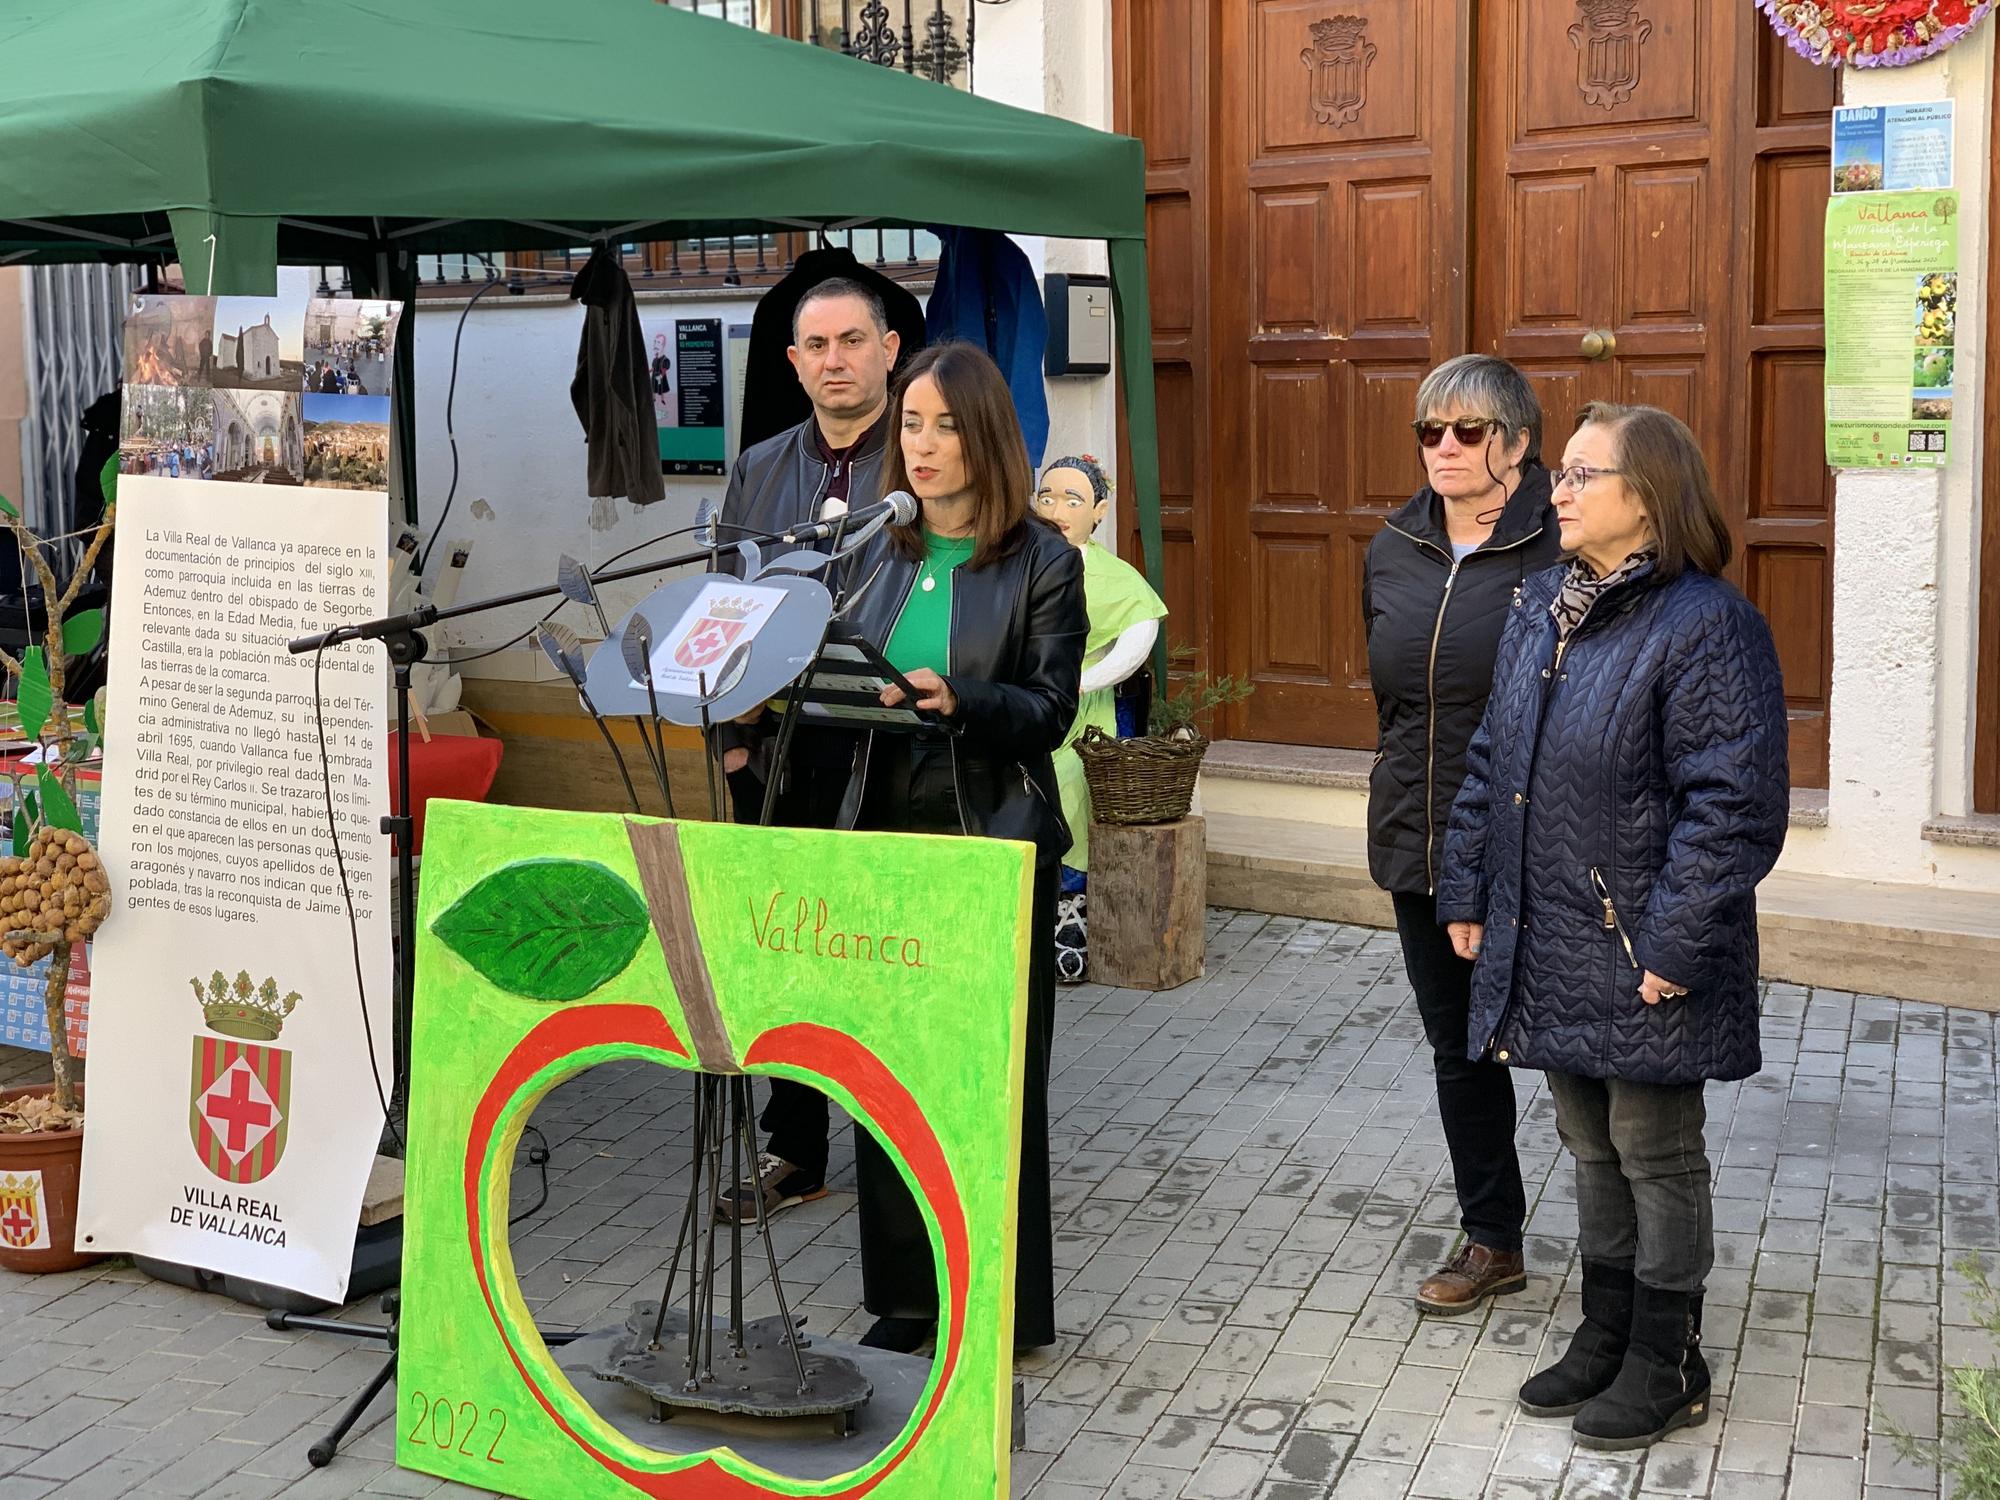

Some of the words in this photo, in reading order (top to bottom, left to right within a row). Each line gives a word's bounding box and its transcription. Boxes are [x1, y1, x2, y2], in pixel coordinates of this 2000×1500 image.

[1840, 108, 1878, 122] BANDO
[1858, 203, 1928, 222] Vallanca
[679, 324, 707, 332] VALLANCA
[145, 528, 159, 542] La
[162, 529, 182, 544] Villa
[185, 531, 211, 546] Real
[214, 534, 228, 548] de
[231, 535, 276, 552] Vallanca
[279, 542, 293, 556] ya
[297, 543, 341, 559] aparece
[345, 547, 361, 558] en
[366, 545, 376, 559] la
[144, 547, 222, 566] documentación
[226, 554, 239, 568] de
[243, 556, 295, 573] principios
[304, 560, 322, 574] del
[326, 562, 354, 579] siglo
[144, 568, 174, 580] como
[178, 570, 226, 586] parroquia
[231, 572, 272, 589] incluida
[277, 579, 292, 591] en
[297, 578, 313, 593] las
[318, 581, 356, 597] tierras
[362, 584, 375, 598] de
[143, 583, 187, 600] Ademuz
[190, 588, 223, 603] dentro
[227, 591, 244, 605] del
[248, 594, 299, 611] obispado
[303, 599, 317, 612] de
[322, 600, 375, 618] Segorbe.
[143, 601, 194, 621] Entonces,
[197, 610, 210, 621] en
[214, 608, 224, 622] la
[227, 610, 255, 625] Edad
[259, 612, 296, 631] Media,
[300, 616, 318, 631] fue
[142, 620, 191, 637] relevante
[194, 625, 220, 640] dada
[224, 631, 237, 642] su
[356, 643, 375, 655] con
[140, 656, 158, 671] las
[160, 658, 193, 674] tierras
[221, 668, 270, 683] comarca.
[141, 638, 185, 656] Castilla,
[187, 646, 202, 657] era
[204, 644, 214, 659] la
[219, 647, 271, 664] población
[273, 653, 297, 667] más
[361, 660, 375, 674] de
[138, 694, 167, 708] mino
[170, 696, 210, 713] General
[212, 701, 226, 716] de
[228, 703, 276, 723] Ademuz,
[280, 712, 295, 723] su
[151, 679, 182, 691] pesar
[225, 687, 273, 703] segunda
[333, 695, 351, 709] del
[353, 697, 374, 712] Tér-
[136, 730, 163, 744] abril
[168, 733, 195, 750] 1695,
[199, 739, 236, 754] cuando
[240, 741, 288, 760] Vallanca
[293, 747, 313, 762] fue
[137, 711, 156, 725] cia
[161, 715, 230, 735] administrativa
[234, 725, 248, 737] no
[253, 724, 281, 743] llegó
[343, 733, 356, 748] 14
[360, 736, 373, 750] de
[136, 747, 162, 762] Villa
[166, 750, 192, 768] Real,
[196, 758, 213, 771] por
[215, 759, 263, 778] privilegio
[267, 765, 290, 779] real
[135, 766, 159, 781] drid
[191, 772, 212, 791] Rey
[213, 775, 247, 793] Carlos
[261, 781, 277, 796] Se
[332, 789, 350, 803] los
[133, 802, 165, 818] dado
[168, 808, 221, 826] constancia
[224, 814, 239, 828] de
[242, 817, 268, 832] ellos
[271, 823, 287, 834] en
[291, 824, 307, 836] un
[134, 785, 154, 798] tes
[174, 791, 187, 802] su
[190, 791, 227, 809] término
[230, 799, 287, 817] municipal,
[350, 812, 371, 827] que-
[132, 823, 149, 834] en
[152, 823, 163, 836] el
[165, 827, 185, 840] que
[187, 830, 235, 846] aparecen
[238, 834, 254, 849] las
[256, 840, 311, 856] personas
[131, 841, 152, 853] ron
[156, 841, 174, 855] los
[177, 846, 222, 865] mojones,
[225, 854, 259, 869] cuyos
[262, 858, 315, 875] apellidos
[319, 863, 335, 877] de
[129, 860, 185, 876] aragonés
[197, 868, 236, 883] navarro
[239, 874, 261, 887] nos
[264, 874, 306, 892] indican
[309, 883, 333, 897] que
[127, 895, 171, 910] gentes
[173, 898, 186, 912] de
[188, 903, 212, 917] esos
[214, 904, 258, 923] lugares.
[129, 876, 180, 895] poblada,
[183, 882, 202, 897] tras
[205, 884, 214, 898] la
[217, 888, 282, 908] reconquista
[285, 896, 301, 910] de
[304, 898, 341, 915] Jaime
[748, 891, 929, 968] Vallanca
[183, 1185, 232, 1212] VILLA
[237, 1196, 283, 1223] REAL
[170, 1206, 194, 1227] DE
[199, 1211, 286, 1248] VALLANCA
[408, 1391, 507, 1464] 2022
